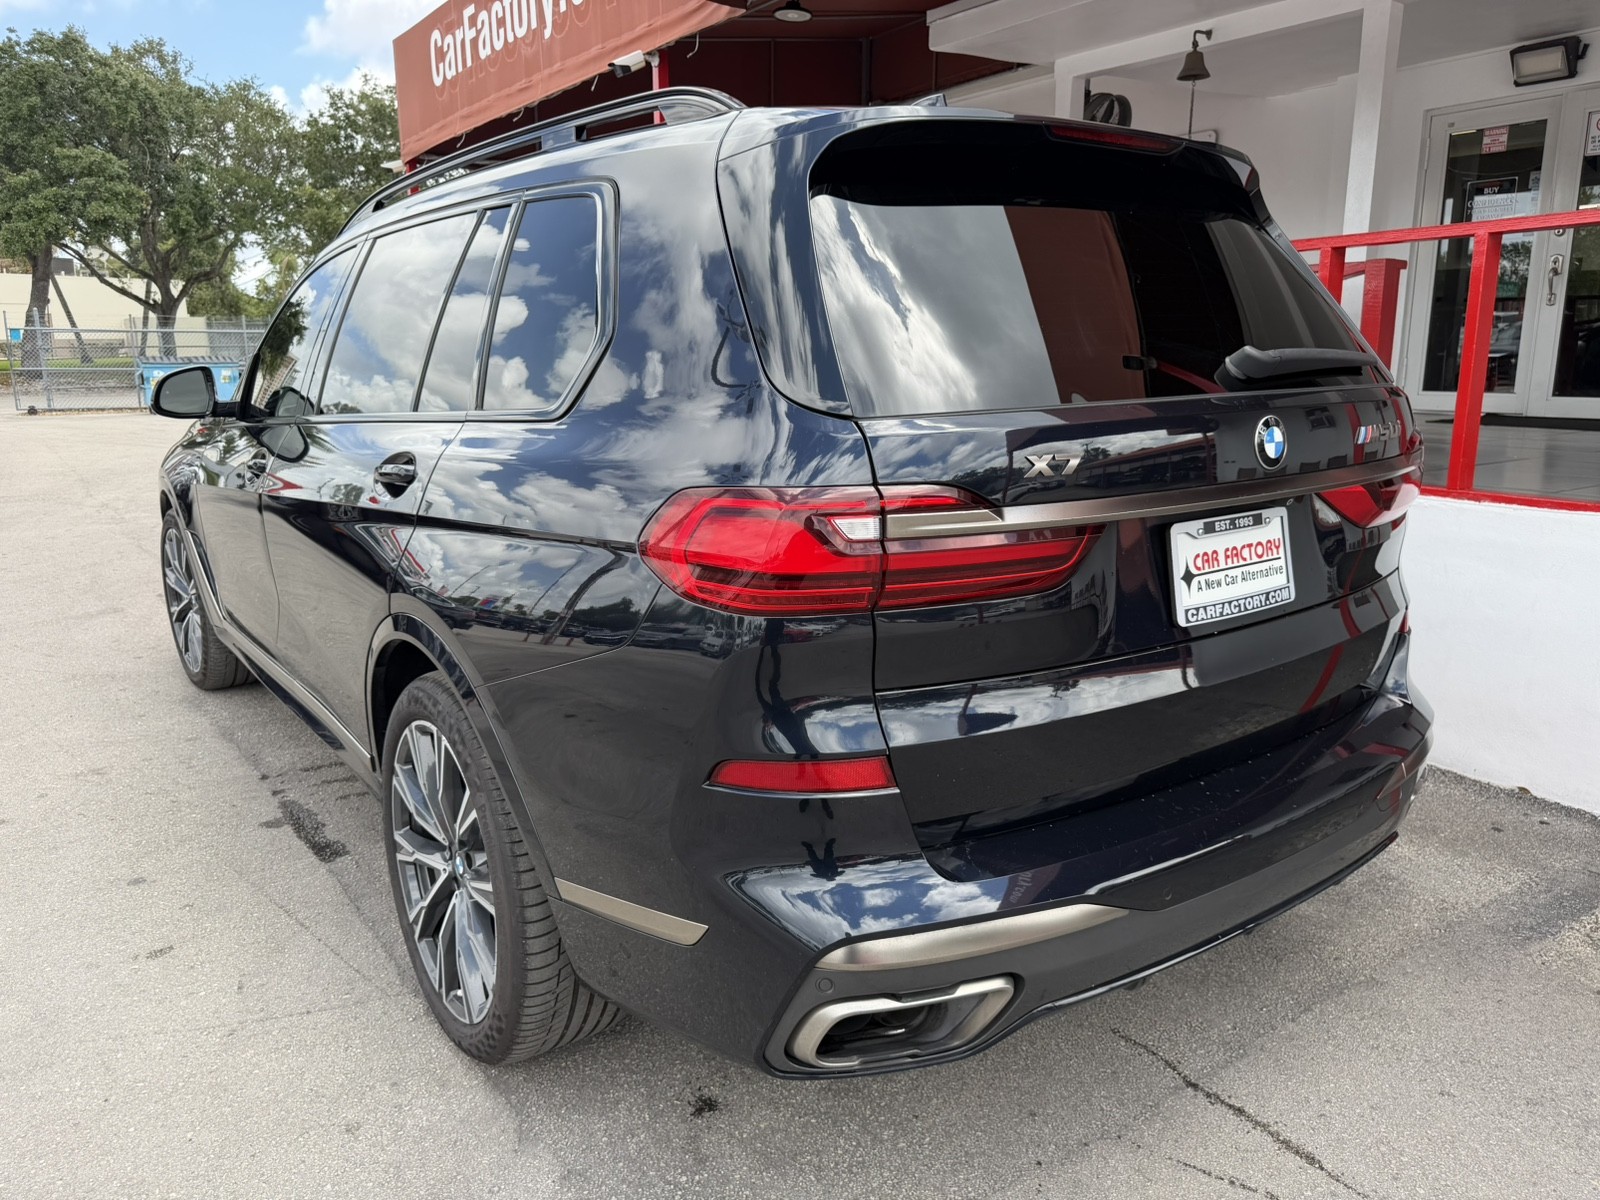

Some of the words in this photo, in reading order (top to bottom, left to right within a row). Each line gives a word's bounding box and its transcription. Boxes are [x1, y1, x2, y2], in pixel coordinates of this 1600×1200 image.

[1484, 186, 1500, 194] BUY
[1023, 453, 1082, 478] X7
[1215, 520, 1233, 531] EST.
[1235, 516, 1254, 528] 1993
[1193, 549, 1220, 572] CAR
[1224, 537, 1281, 566] FACTORY
[1197, 580, 1204, 593] A
[1205, 577, 1222, 590] New
[1224, 574, 1239, 586] Car
[1241, 564, 1284, 583] Alternative
[1187, 587, 1290, 622] CARFACTORY.COM
